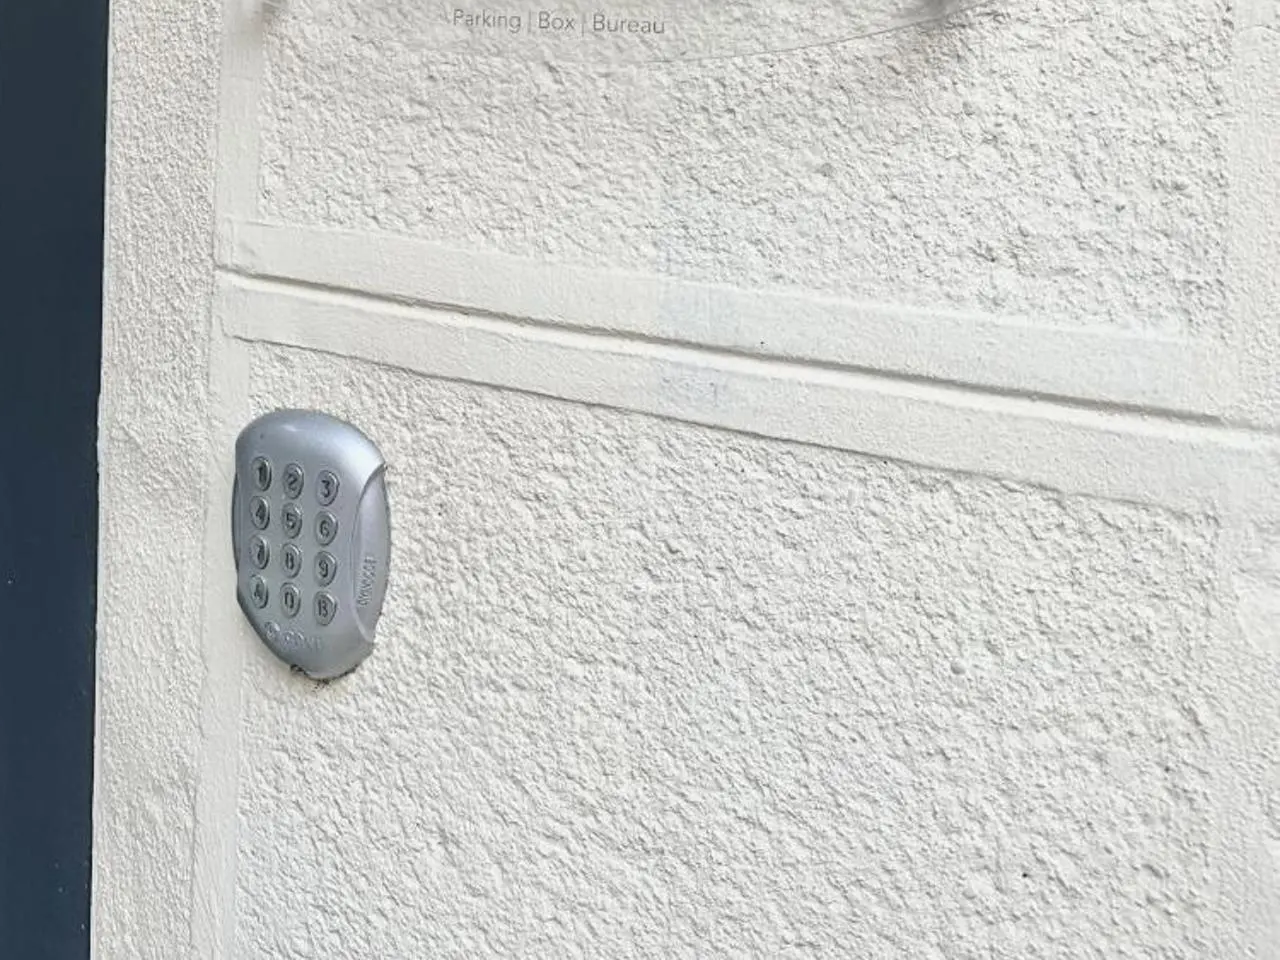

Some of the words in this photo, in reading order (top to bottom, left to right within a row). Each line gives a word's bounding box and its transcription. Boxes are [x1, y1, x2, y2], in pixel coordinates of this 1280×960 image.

[452, 8, 521, 34] Parking
[538, 10, 576, 31] Box
[592, 12, 666, 35] Bureau
[257, 464, 267, 487] 1
[287, 473, 298, 492] 2
[320, 479, 331, 498] 3
[255, 504, 267, 522] 4
[286, 512, 297, 530] 5
[319, 520, 330, 538] 6
[318, 559, 329, 578] 9
